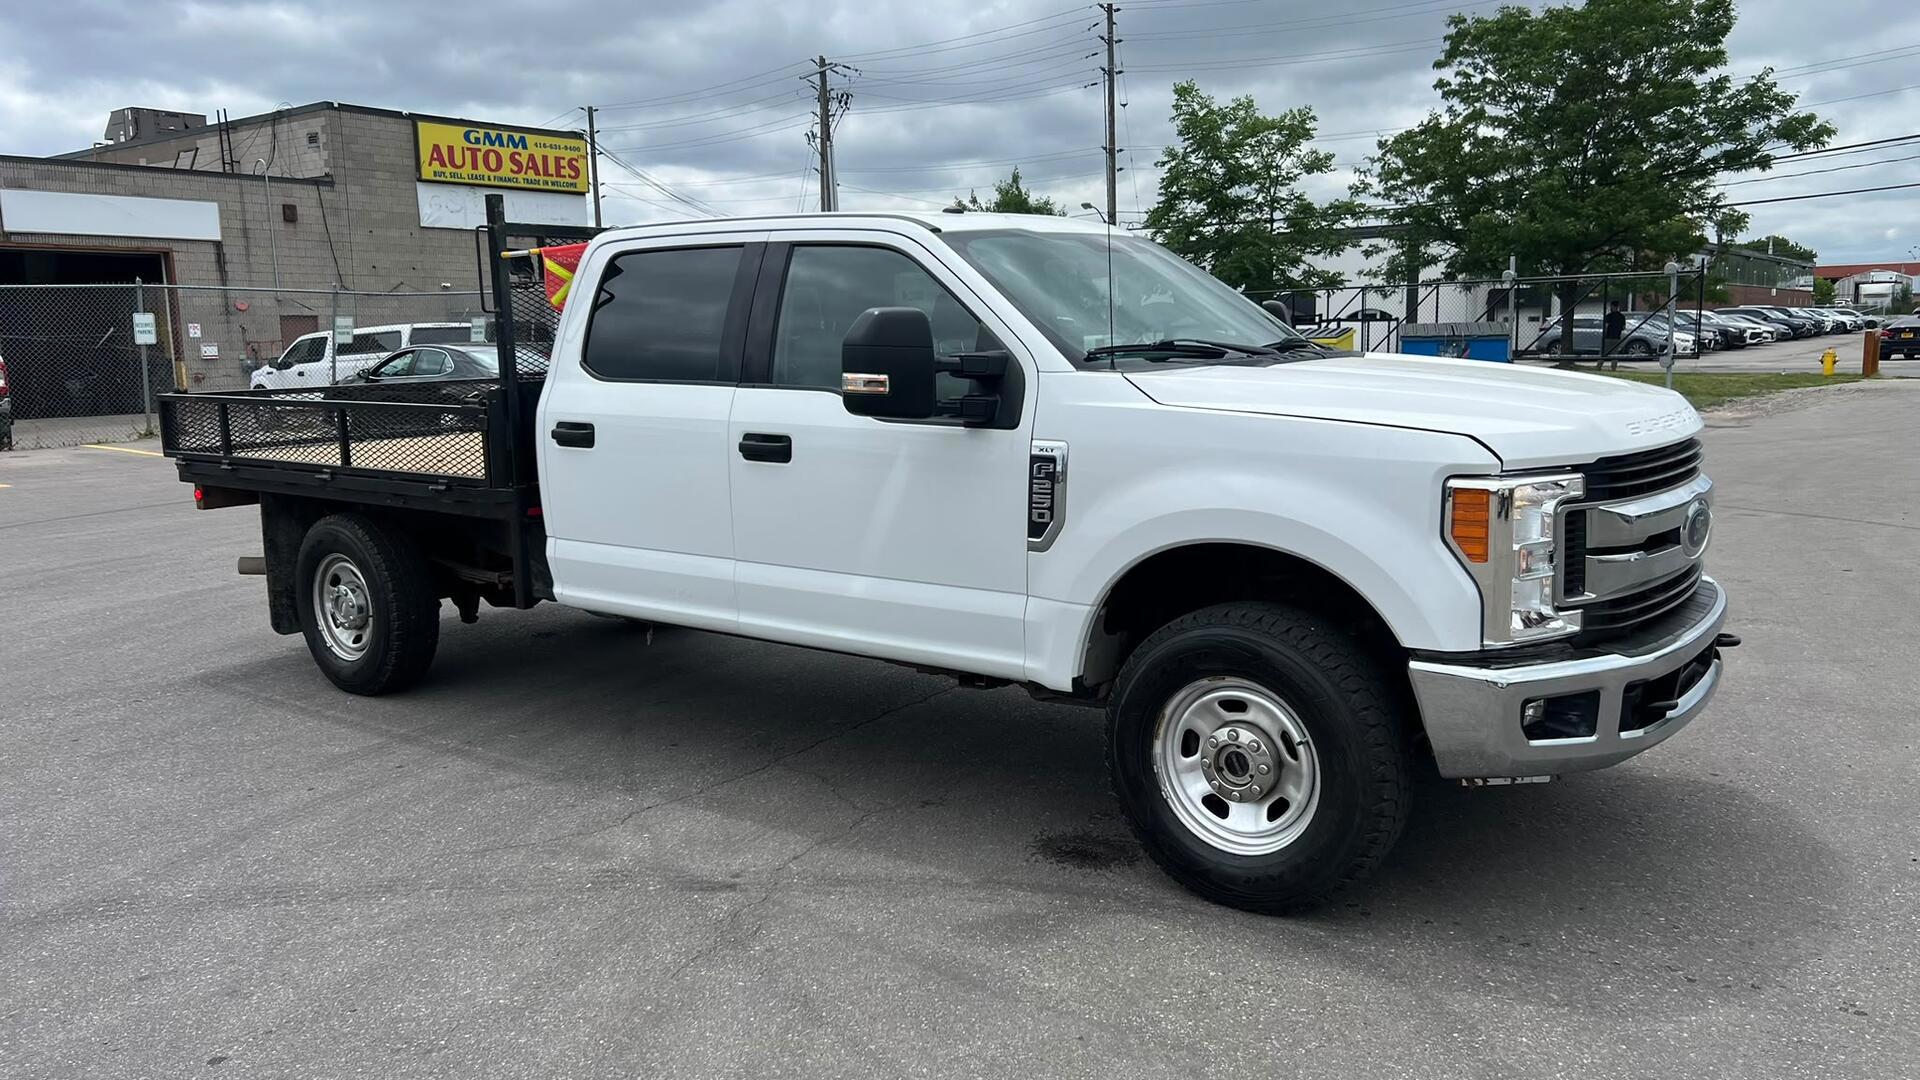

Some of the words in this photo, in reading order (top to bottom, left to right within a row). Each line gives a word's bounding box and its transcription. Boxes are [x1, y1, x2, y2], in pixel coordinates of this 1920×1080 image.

[463, 129, 528, 150] GMM
[428, 144, 504, 173] AUTO
[509, 151, 581, 180] SALES
[433, 170, 448, 179] BUY,
[467, 173, 485, 181] LEASE
[523, 178, 541, 186] TRADE
[551, 181, 577, 189] WELCOME
